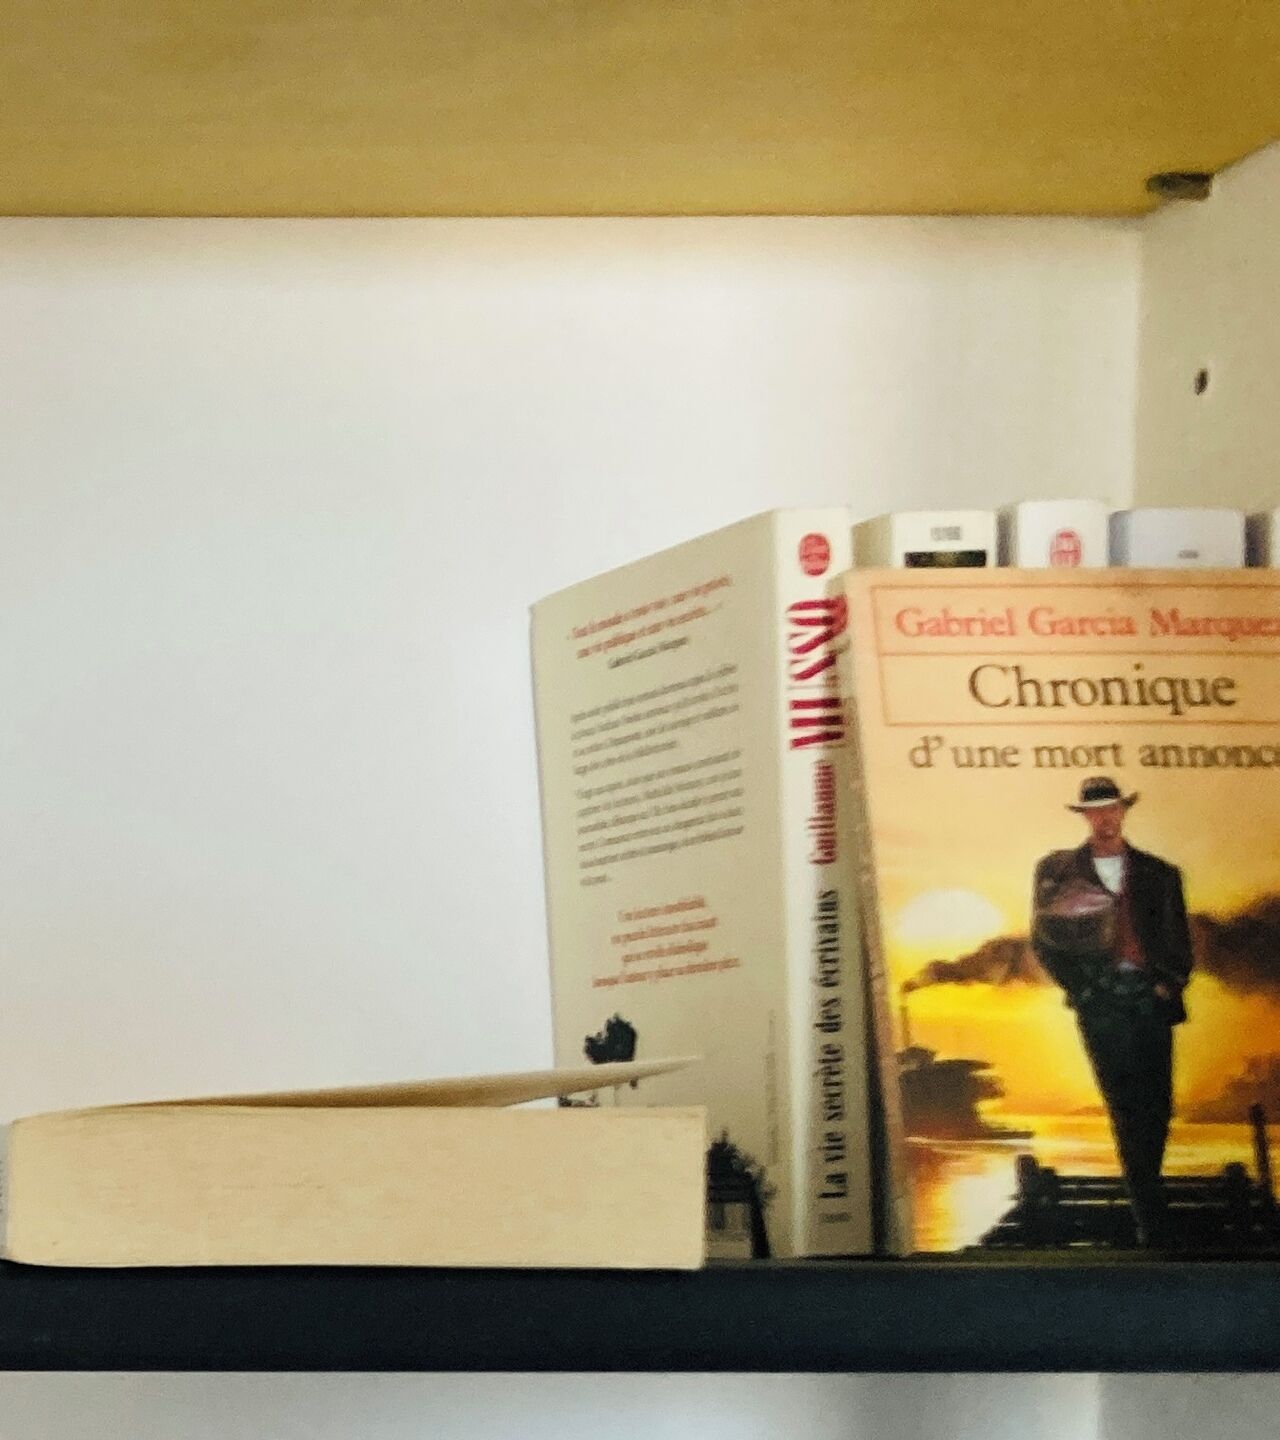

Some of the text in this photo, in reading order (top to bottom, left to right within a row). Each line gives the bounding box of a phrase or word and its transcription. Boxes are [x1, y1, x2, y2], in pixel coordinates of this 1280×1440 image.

[895, 605, 1017, 637] Gabriel
[968, 664, 1237, 716] Chronique
[909, 736, 1124, 770] d'une mort
[811, 889, 848, 1199] La vie secrète des écrivains
